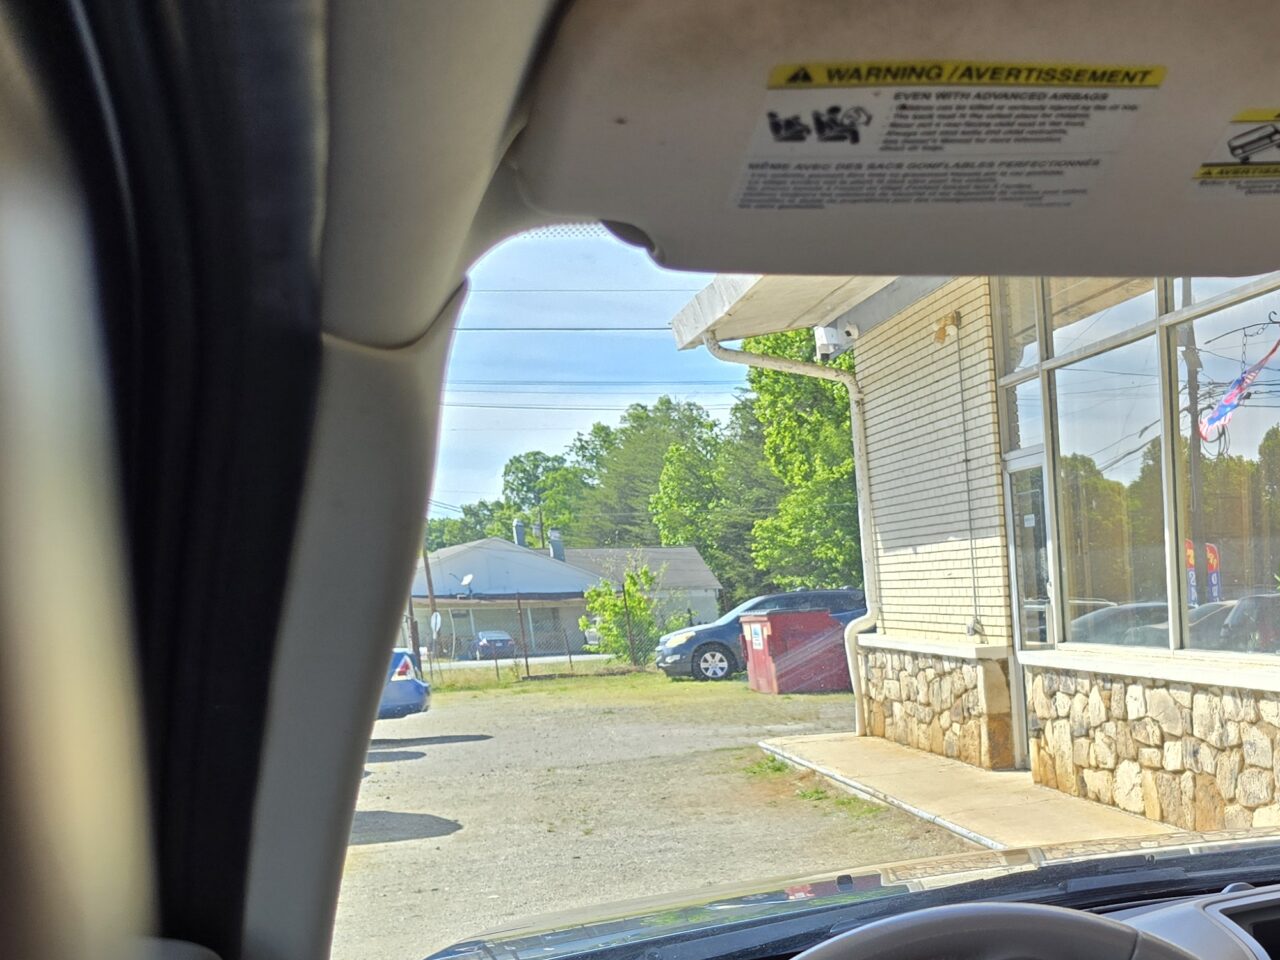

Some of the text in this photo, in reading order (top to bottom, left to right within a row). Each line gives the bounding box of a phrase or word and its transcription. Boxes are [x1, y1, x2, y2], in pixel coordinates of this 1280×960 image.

[826, 66, 944, 83] WARNING
[935, 92, 971, 100] WITH
[973, 92, 1047, 100] ADVANCED
